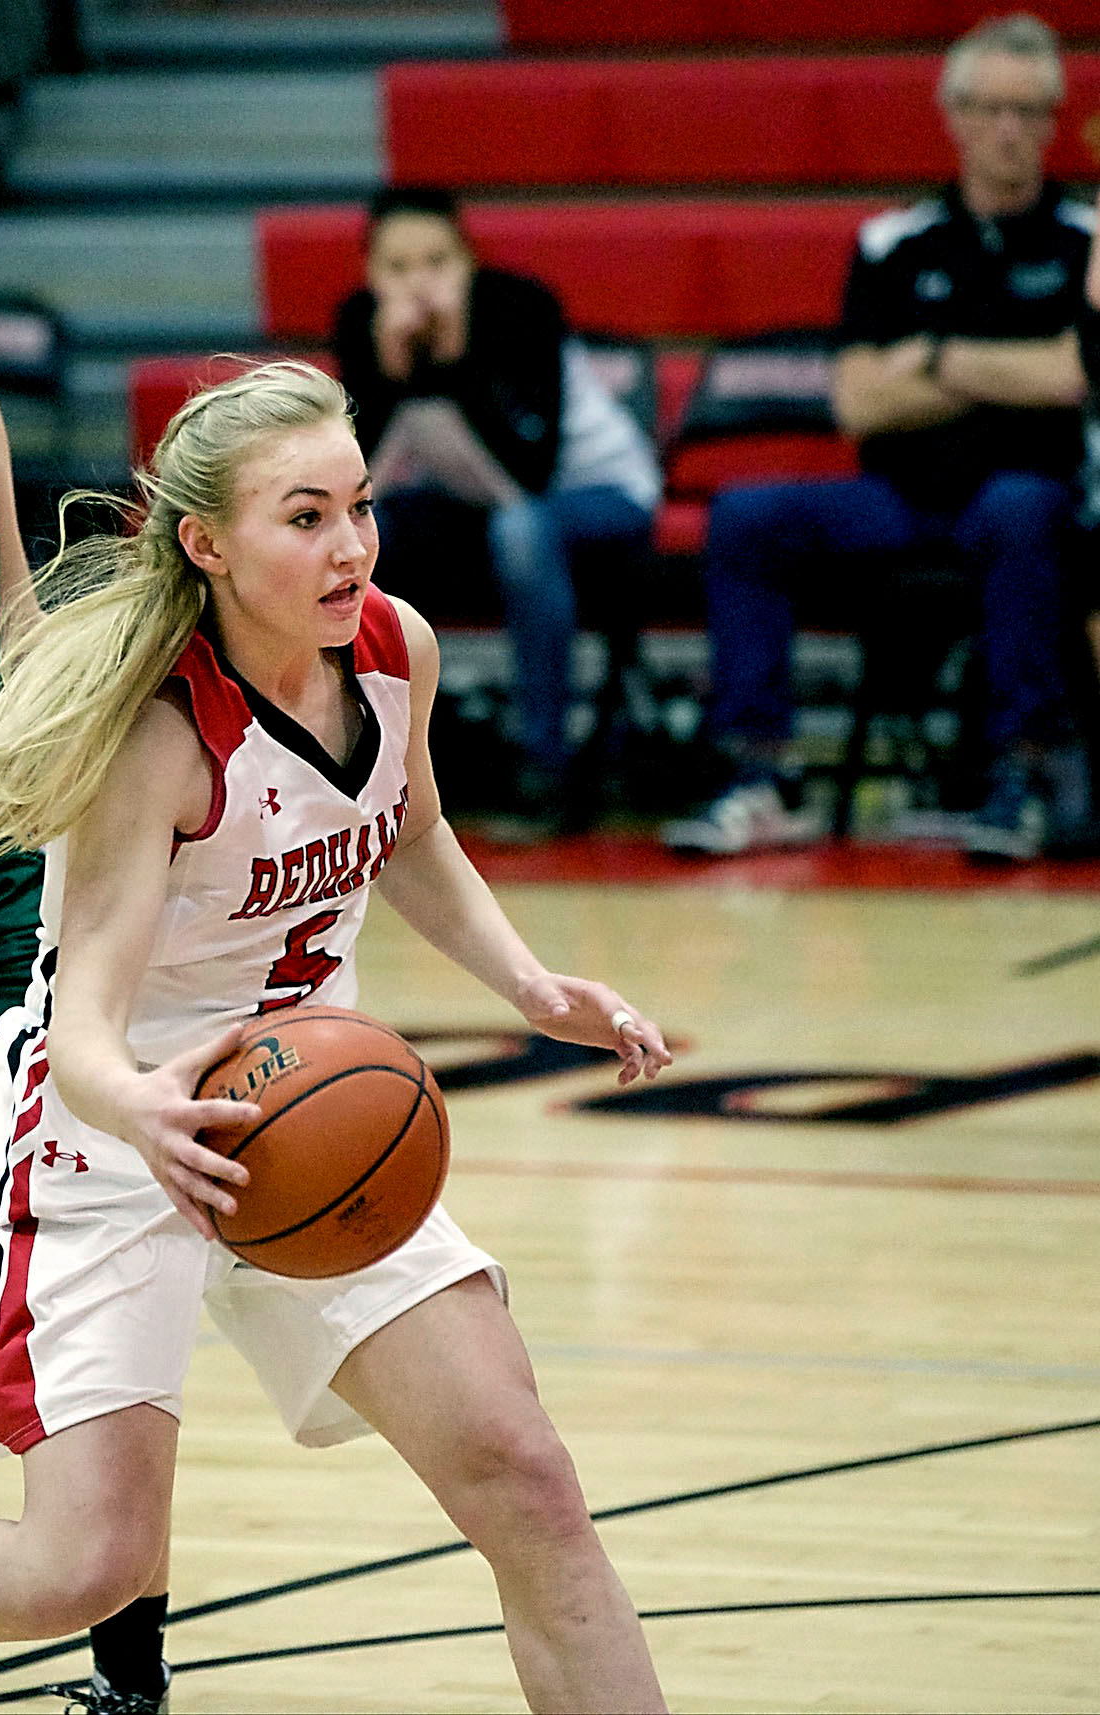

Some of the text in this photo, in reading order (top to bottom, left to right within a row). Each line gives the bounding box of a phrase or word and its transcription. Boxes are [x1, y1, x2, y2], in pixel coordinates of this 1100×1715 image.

[228, 783, 408, 920] REDHAW
[255, 909, 344, 1015] 5
[227, 1045, 300, 1103] LITE
